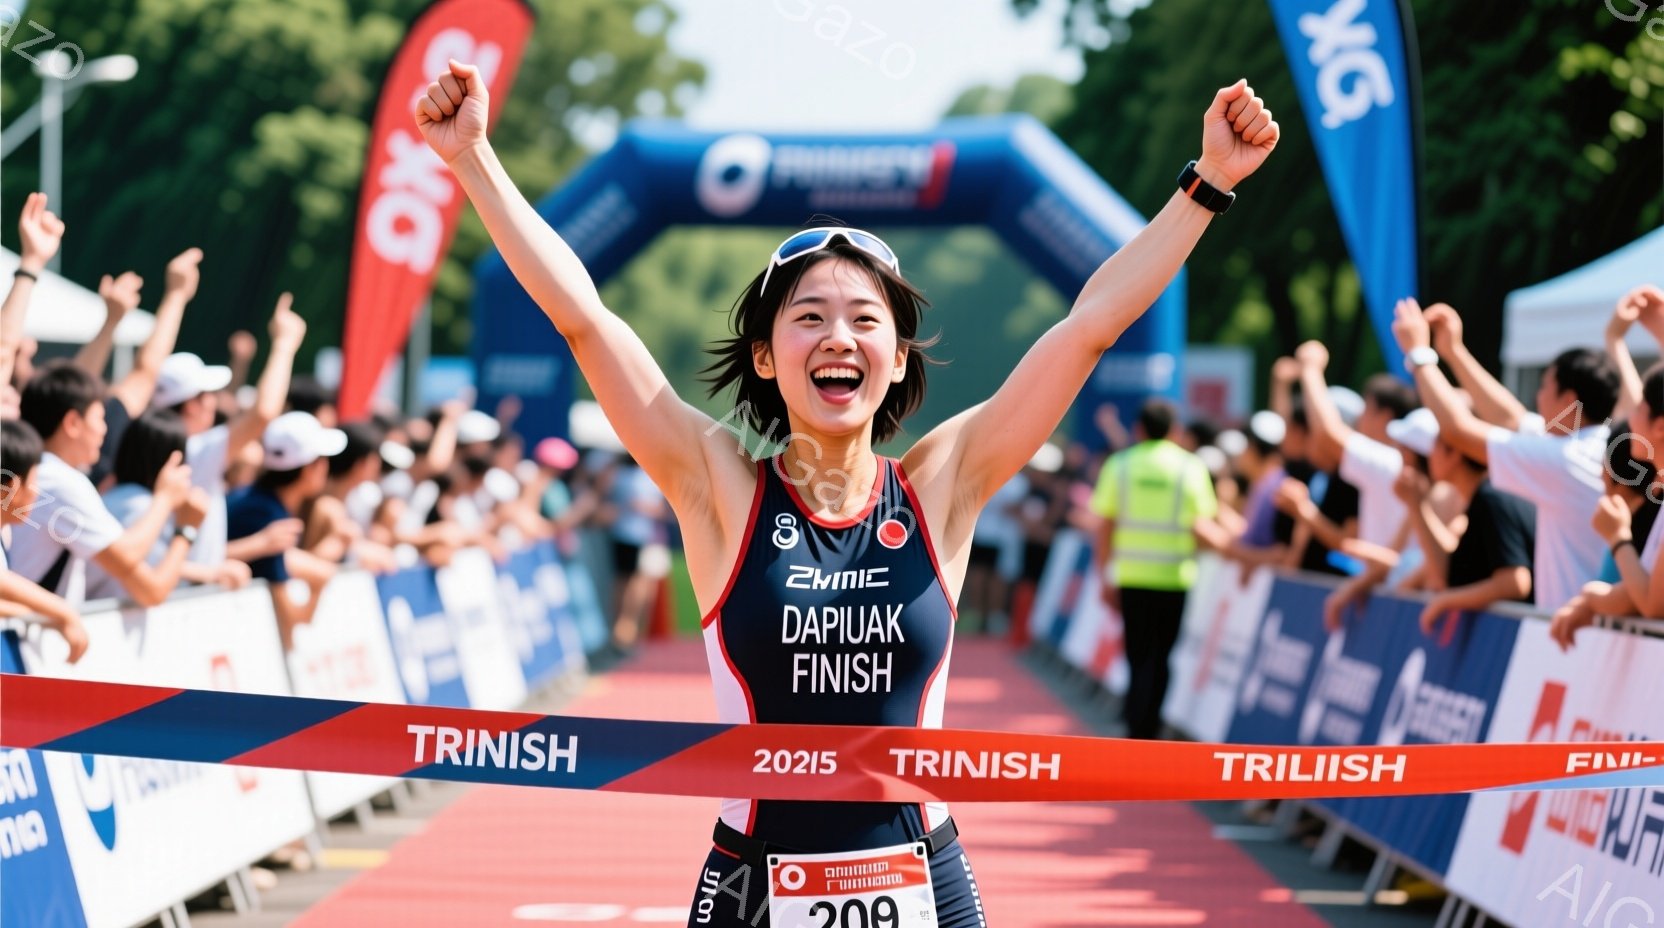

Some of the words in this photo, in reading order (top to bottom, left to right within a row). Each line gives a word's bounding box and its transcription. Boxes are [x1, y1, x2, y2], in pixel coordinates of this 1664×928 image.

[781, 603, 905, 644] DAPIUAK
[792, 652, 893, 693] FINISH
[407, 724, 578, 773] TRINISH
[889, 748, 1061, 781] TRINISH
